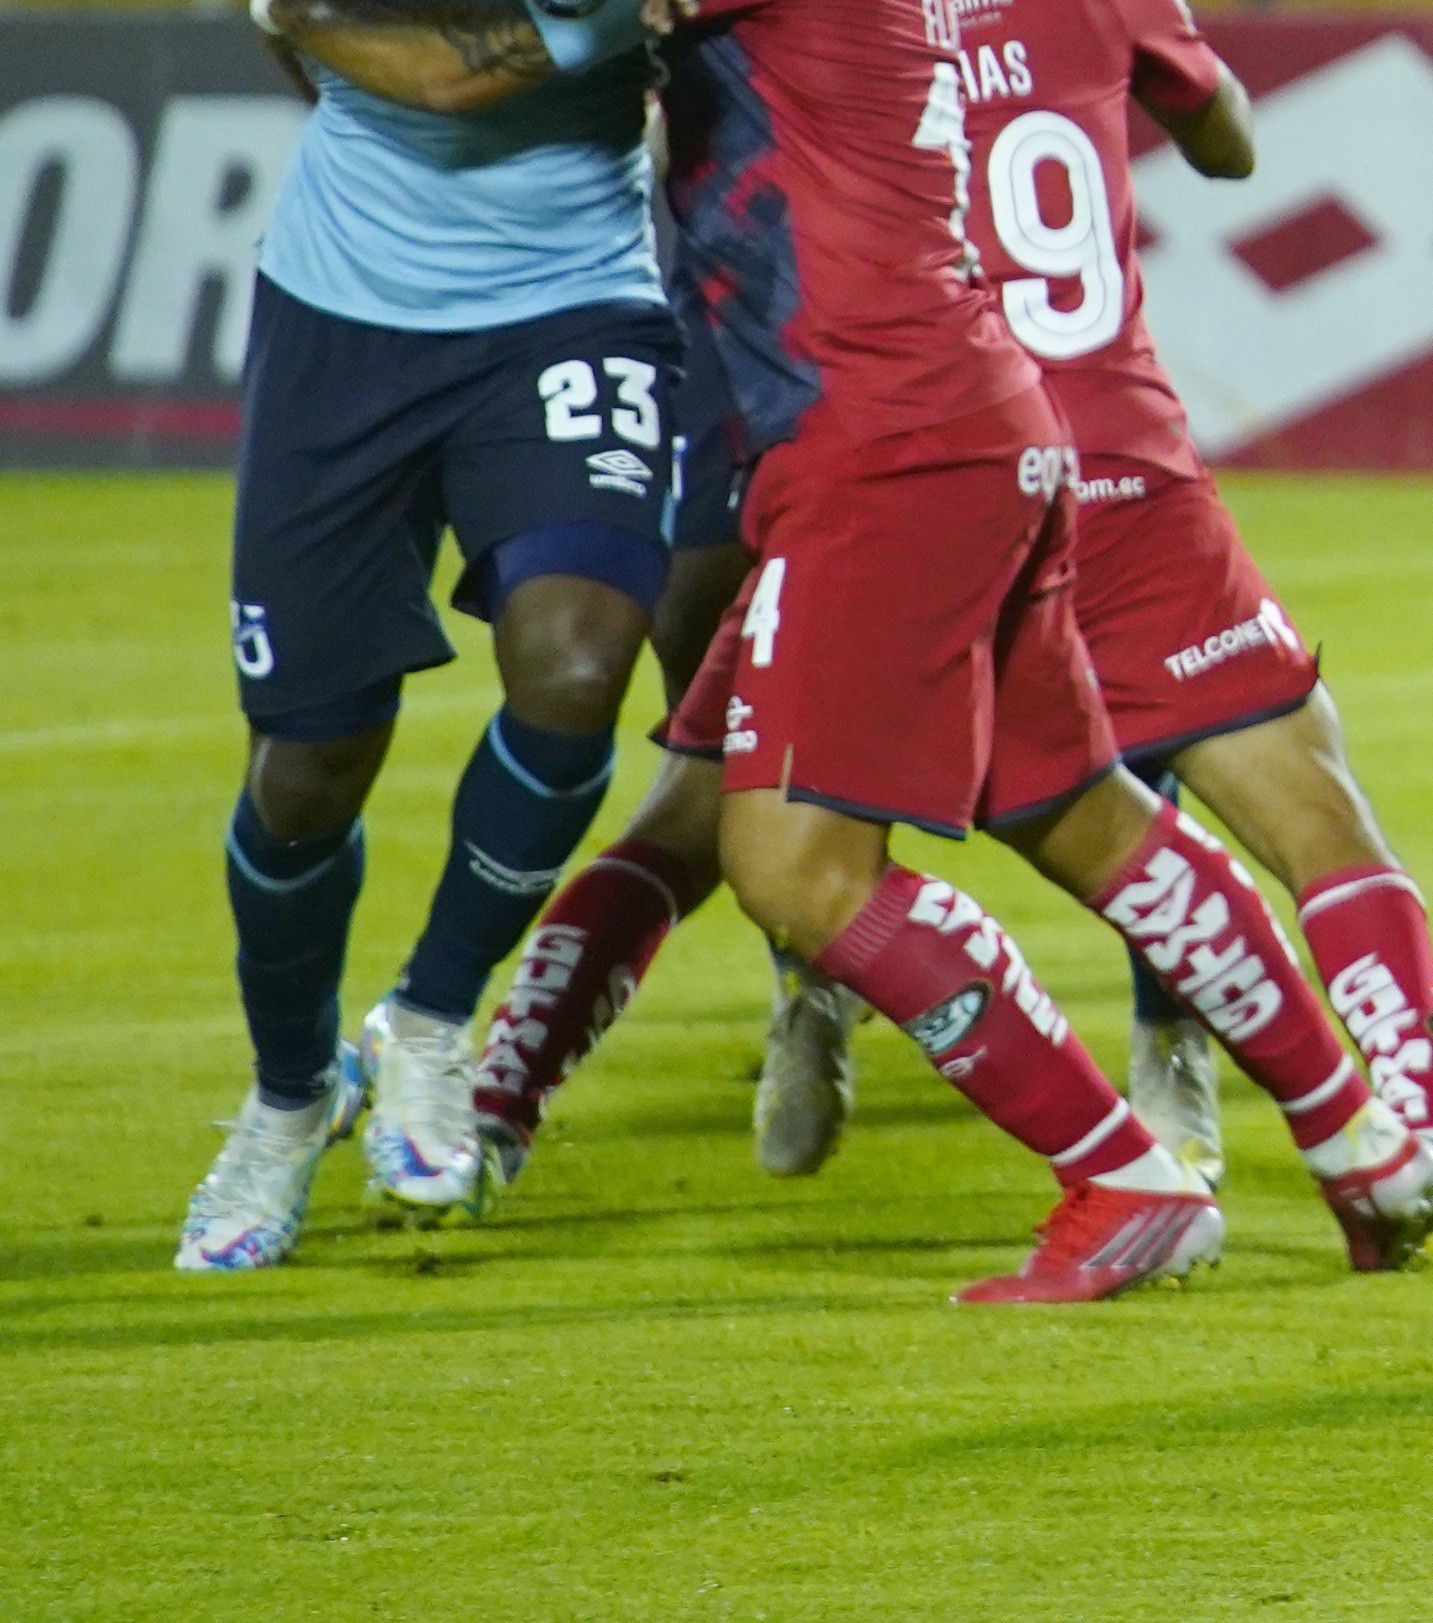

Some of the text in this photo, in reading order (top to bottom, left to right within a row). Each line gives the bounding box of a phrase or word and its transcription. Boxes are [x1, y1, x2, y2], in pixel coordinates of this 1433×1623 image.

[956, 39, 1034, 104] IAS
[987, 109, 1125, 361] 9
[537, 356, 662, 450] 23
[740, 556, 786, 668] 4
